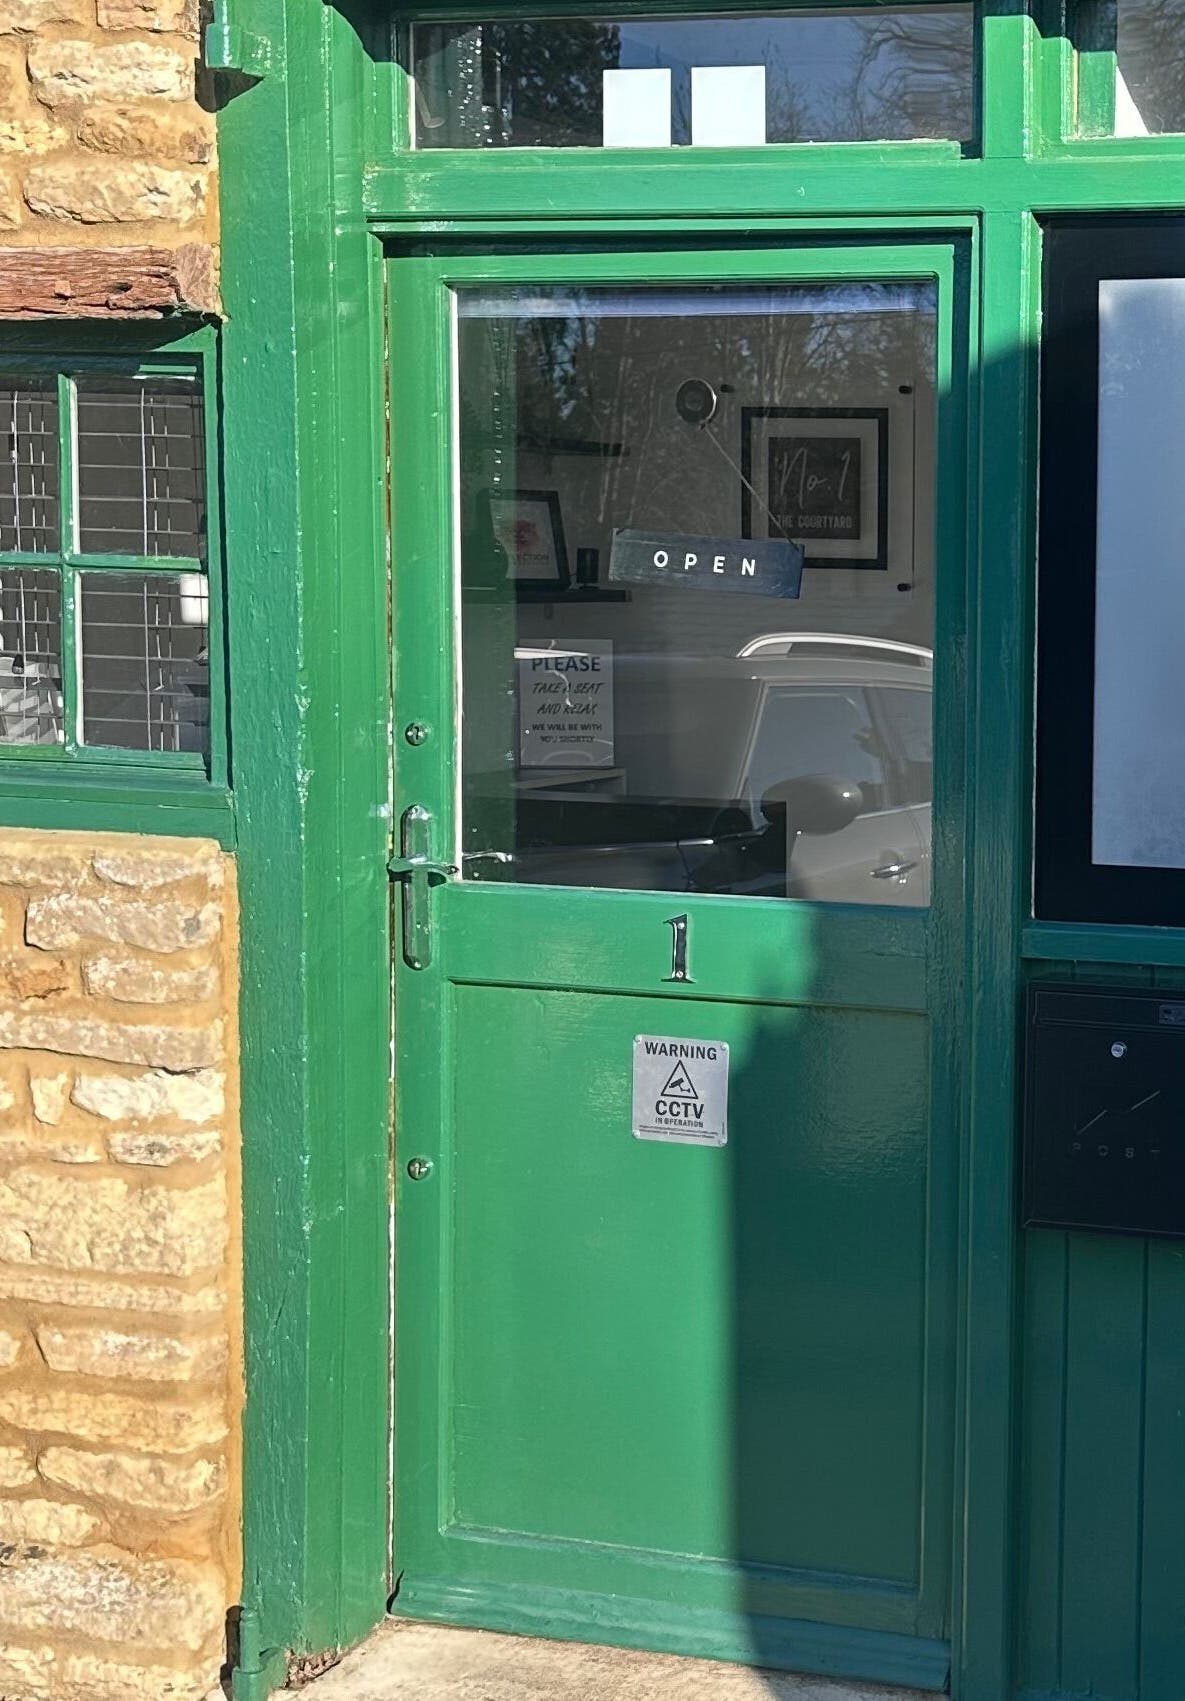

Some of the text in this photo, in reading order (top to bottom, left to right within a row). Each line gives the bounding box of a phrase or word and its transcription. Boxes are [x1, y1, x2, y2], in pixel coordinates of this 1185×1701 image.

[776, 514, 853, 529] THE COURTYARD
[653, 550, 756, 577] OPEN
[532, 656, 601, 672] PLEASE
[532, 682, 604, 694] TAKE A SEAT
[536, 703, 599, 715] AND RELAX
[532, 723, 603, 731] WE WILL BE WITH
[660, 913, 696, 984] 1
[644, 1041, 717, 1061] WARNING
[655, 1099, 704, 1119] CCTV
[655, 1117, 704, 1129] IN OPERATION
